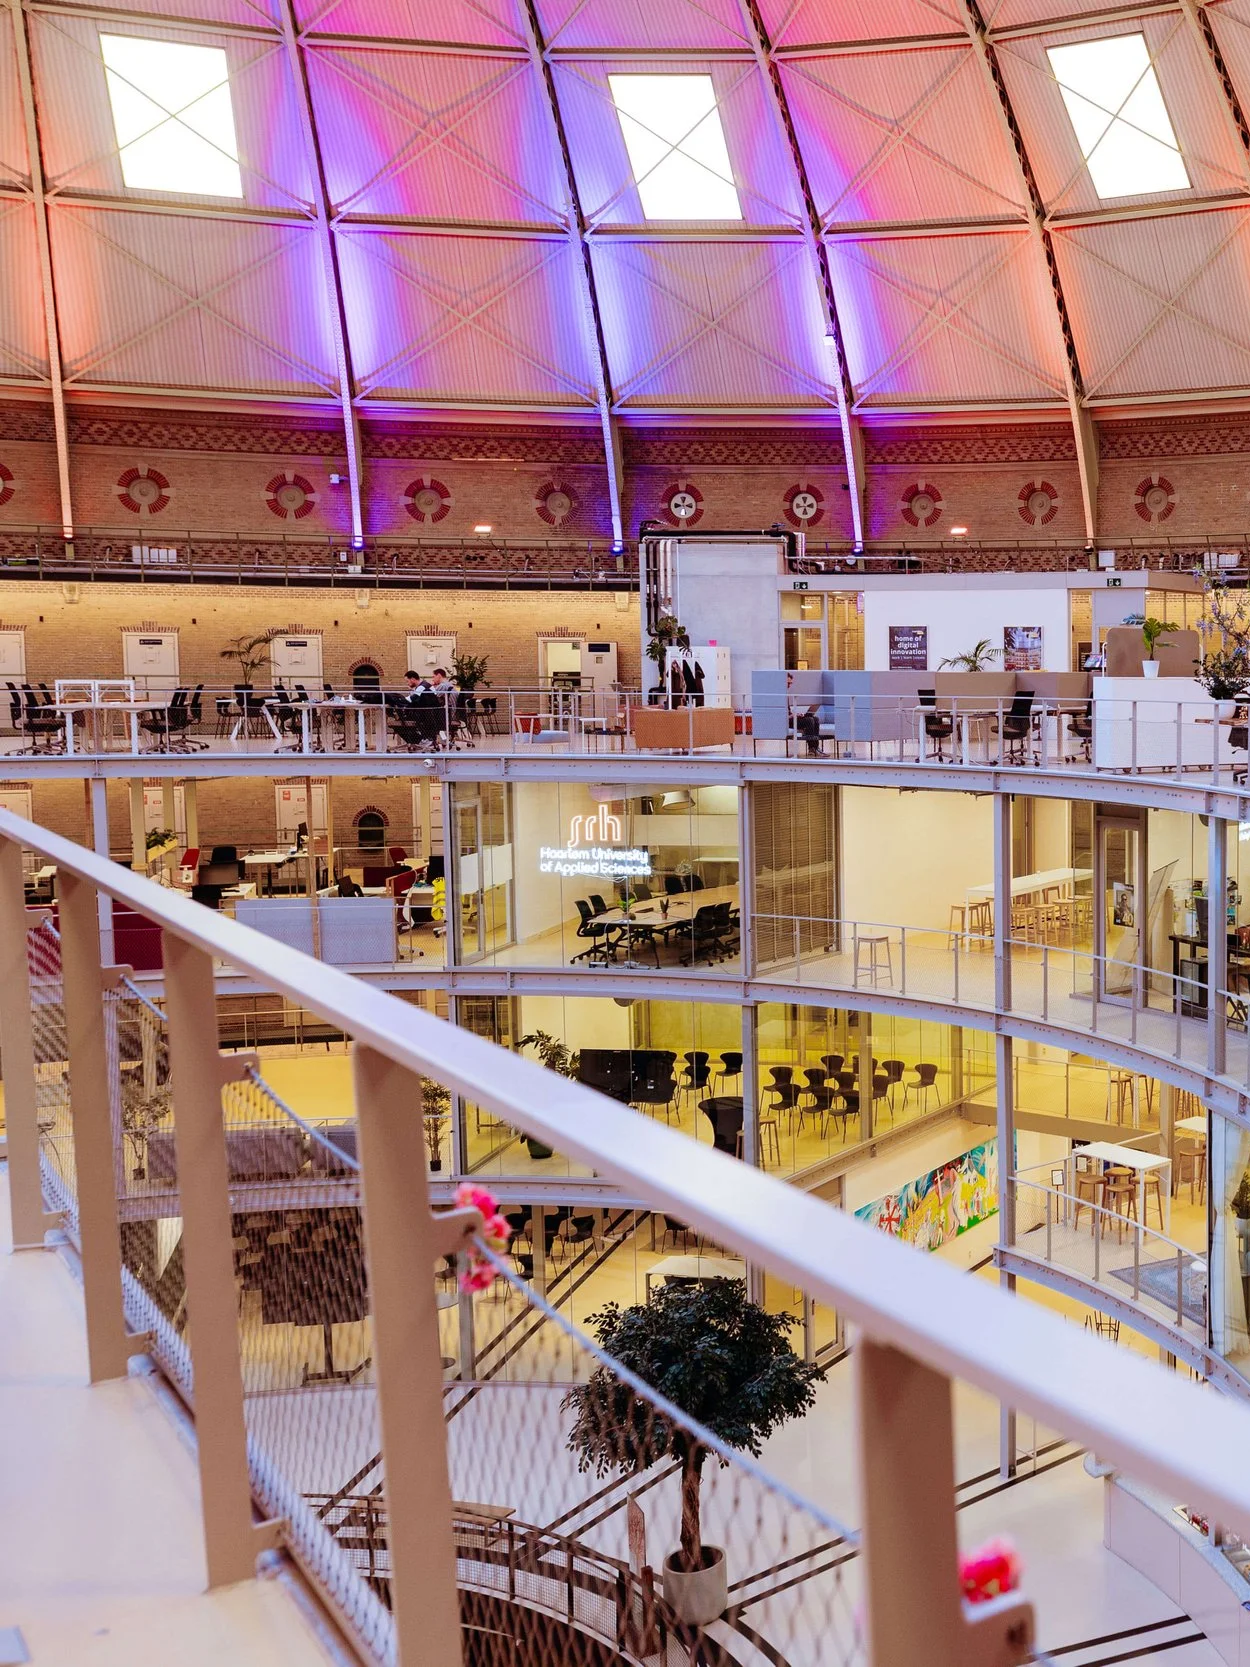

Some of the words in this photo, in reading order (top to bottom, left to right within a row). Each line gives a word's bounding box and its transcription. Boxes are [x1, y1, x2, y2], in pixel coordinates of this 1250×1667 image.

[897, 642, 919, 650] digital
[567, 804, 621, 848] srh
[540, 847, 590, 860] Haarlem
[591, 847, 649, 864] University
[540, 861, 554, 873] of
[554, 861, 600, 876] Applied
[600, 862, 652, 876] Sciences
